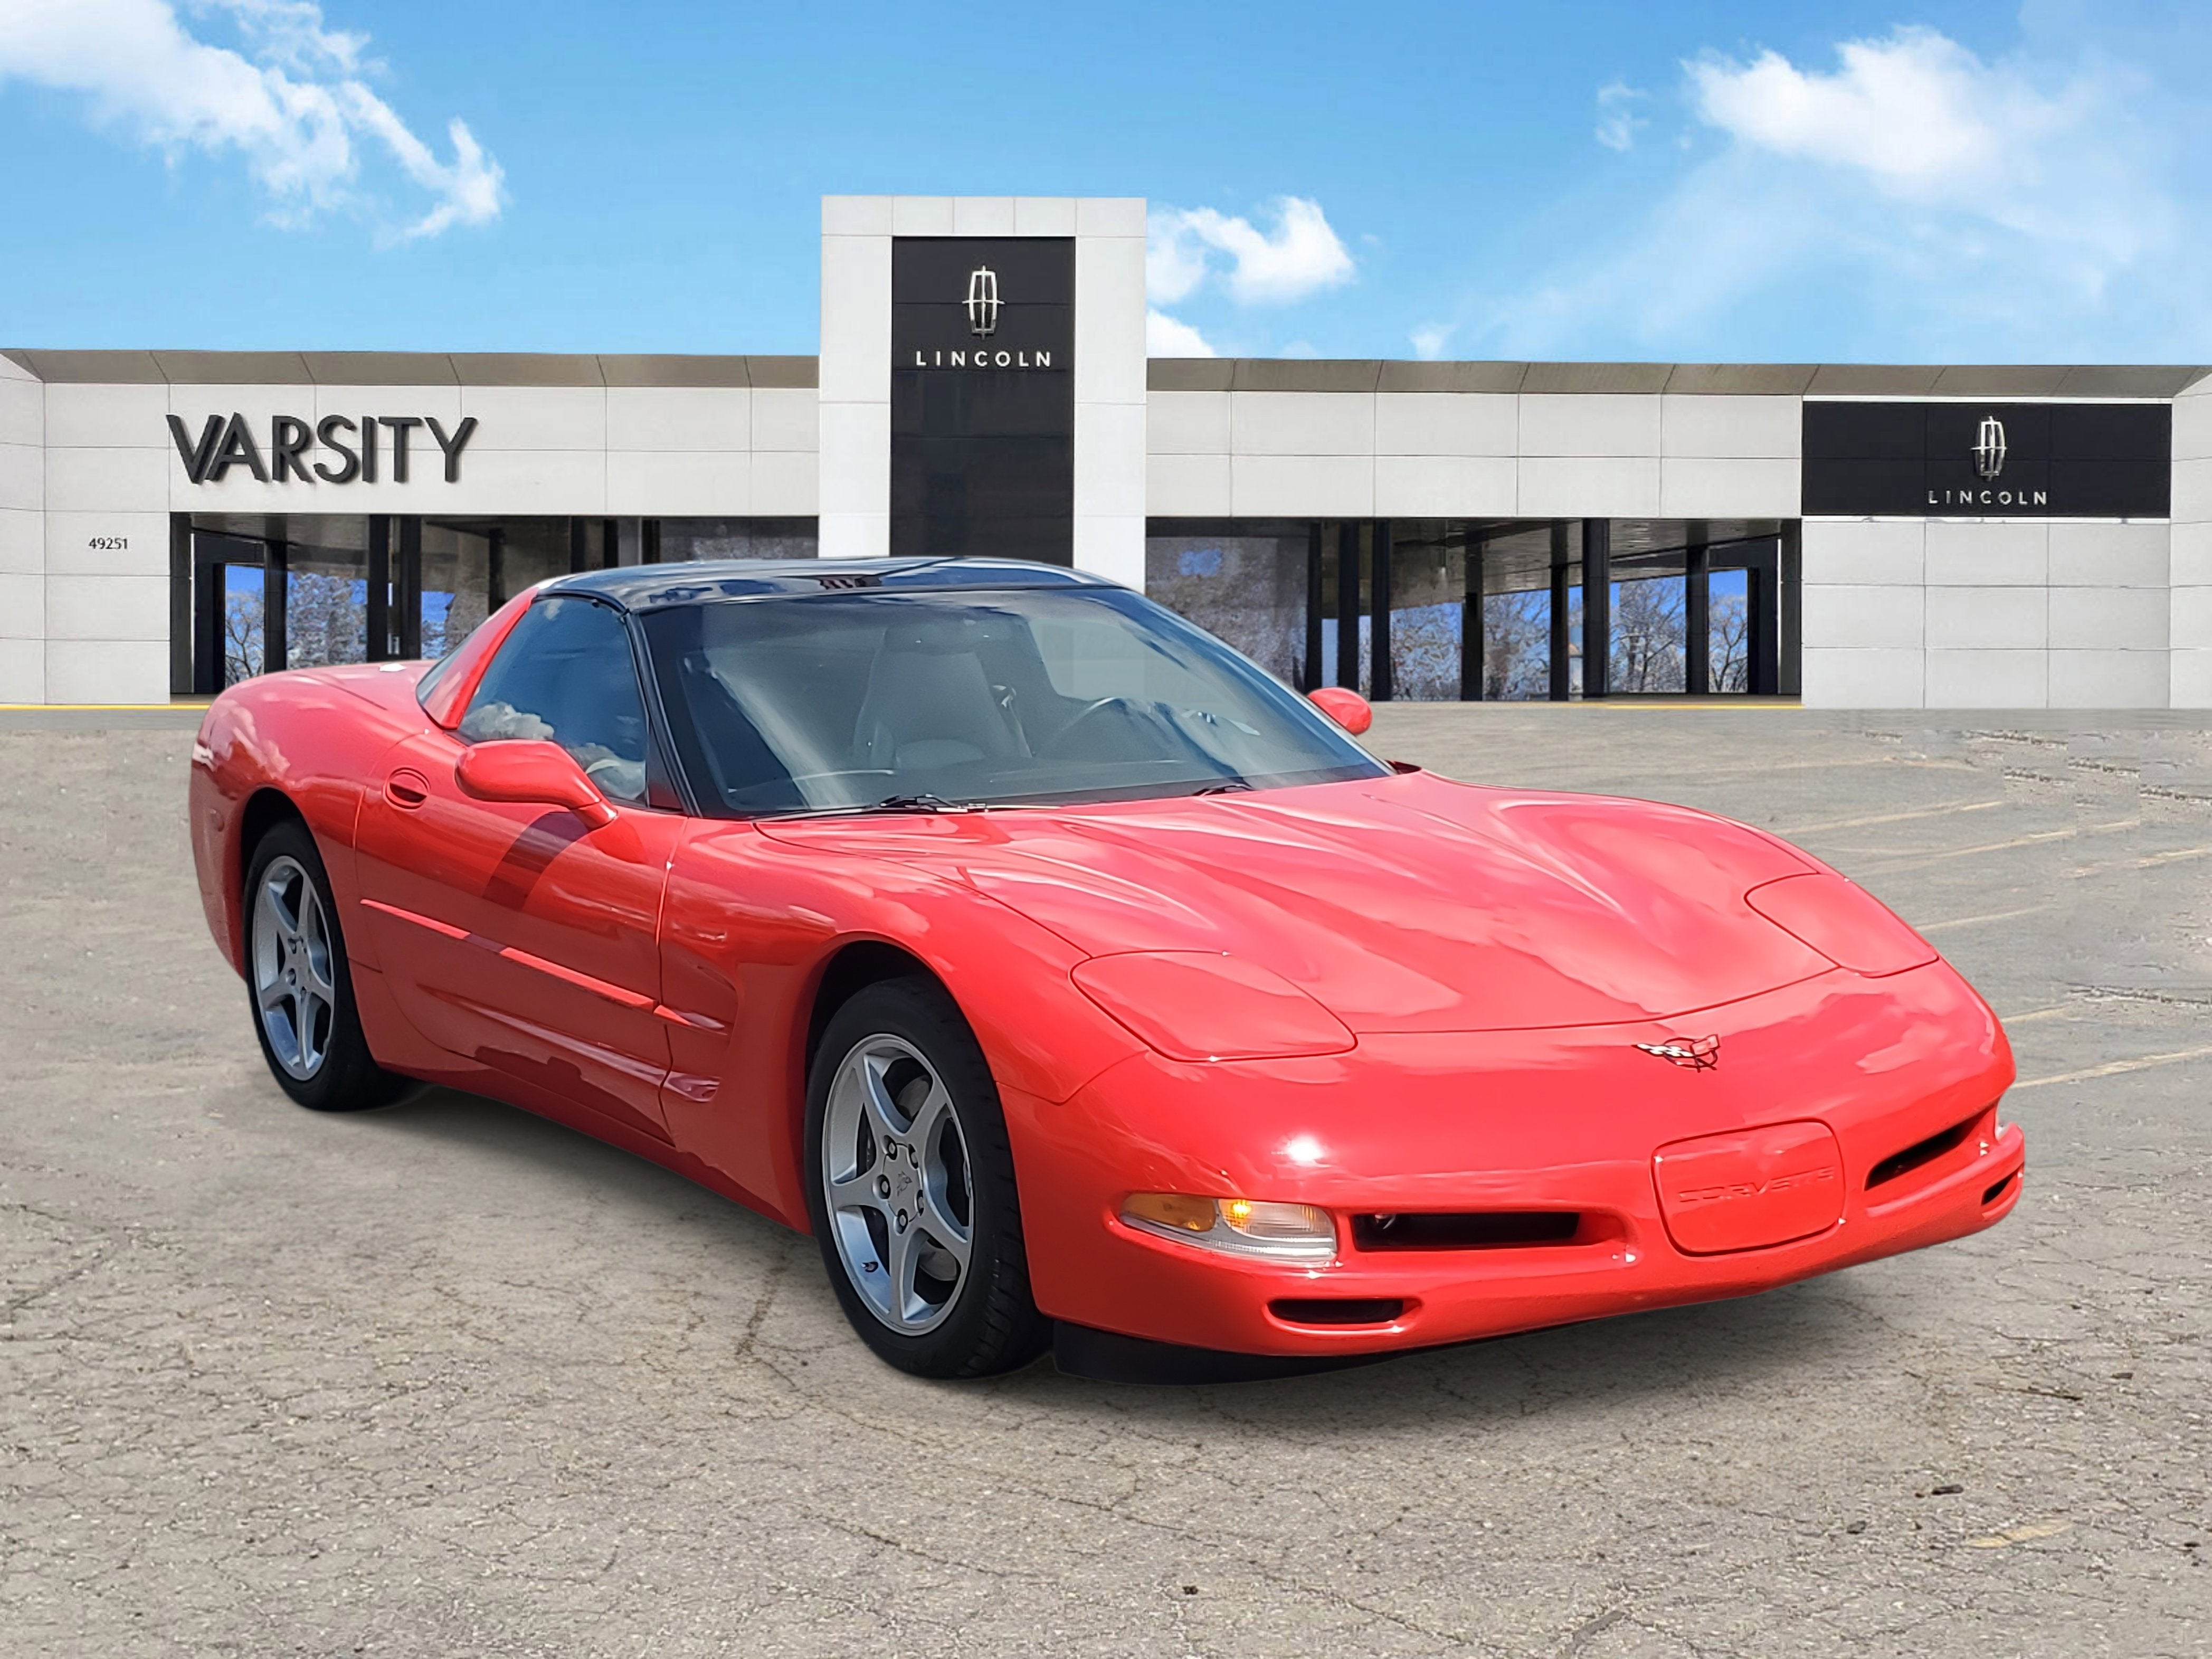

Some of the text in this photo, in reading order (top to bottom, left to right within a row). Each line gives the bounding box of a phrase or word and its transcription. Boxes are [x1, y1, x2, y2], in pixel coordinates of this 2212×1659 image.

[916, 350, 1050, 367] LINCOLN
[166, 412, 478, 484] VARSITY
[1928, 490, 2047, 505] LINCOLN
[88, 537, 128, 549] 49251
